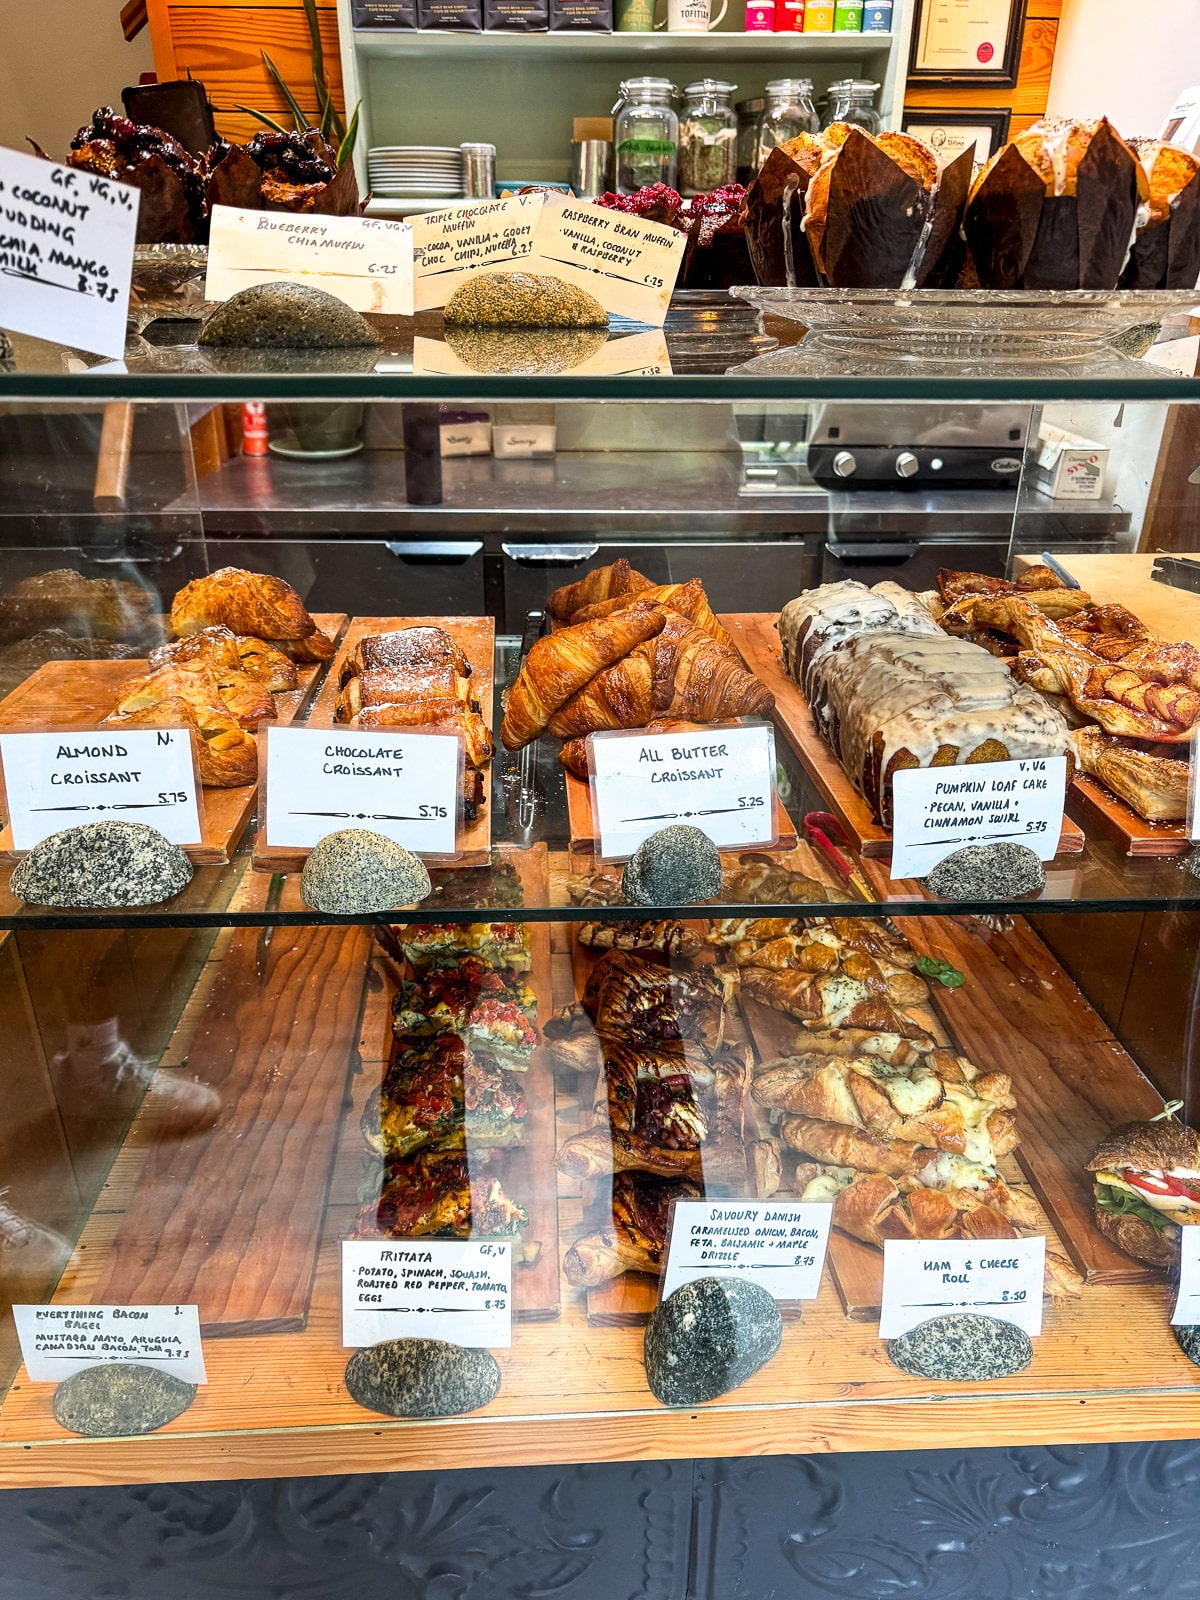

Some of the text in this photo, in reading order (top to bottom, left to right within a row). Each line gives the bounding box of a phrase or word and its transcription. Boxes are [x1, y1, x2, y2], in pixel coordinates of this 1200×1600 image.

[12, 186, 90, 221] COCONUT
[424, 212, 454, 225] TRIPLE
[456, 202, 508, 219] CHOCOLATE
[256, 217, 328, 236] BLUEBERRY
[442, 220, 476, 234] MUFFIN
[561, 208, 610, 230] RASPBERRY
[614, 224, 640, 238] BRAN
[643, 233, 674, 248] MUFFIN
[288, 236, 318, 247] CHIA
[456, 232, 491, 248] VANILLA
[503, 226, 531, 238] GOOEY
[512, 240, 533, 256] 6.25
[602, 241, 642, 258] COCONUT
[422, 255, 446, 267] CHOC
[580, 245, 632, 266] RASPBERRY
[48, 248, 109, 278] MANGO
[368, 264, 398, 274] 6.25
[644, 274, 664, 288] 6.25
[56, 744, 128, 760] ALMOND
[324, 746, 404, 760] CHOCOLATE
[638, 744, 729, 763] ALL BUTTER
[936, 778, 1048, 796] PUMPKIN LOAF CAKE
[158, 792, 188, 804] 5.75
[738, 796, 765, 808] 5.25
[970, 798, 1010, 811] VANILLA
[418, 804, 448, 818] 5.75
[924, 812, 1020, 828] CINNAMON SWIRL
[1026, 820, 1048, 832] 5.75
[710, 1208, 802, 1223] SAVOURY DANISH
[690, 1225, 750, 1237] CARAMELISED
[720, 1238, 766, 1249] BALSAMIC
[776, 1240, 809, 1250] MAPLE
[380, 1250, 433, 1264] FRITTATA
[700, 1250, 740, 1262] DRIZZLE
[794, 1255, 816, 1266] 8.75
[924, 1260, 952, 1272] HAM
[980, 1258, 1020, 1270] CHEESE
[356, 1278, 398, 1290] ROASTED
[404, 1280, 423, 1290] RED
[942, 1273, 970, 1284] ROLL
[358, 1293, 383, 1303] EGGS
[1002, 1290, 1027, 1302] 8.50
[484, 1300, 506, 1310] 8.75
[36, 1310, 104, 1321] EVERYTHING
[112, 1308, 149, 1320] BACON
[64, 1322, 101, 1330] BAGEL
[36, 1334, 88, 1342] MUSTARD
[36, 1343, 96, 1352] CANADIAN
